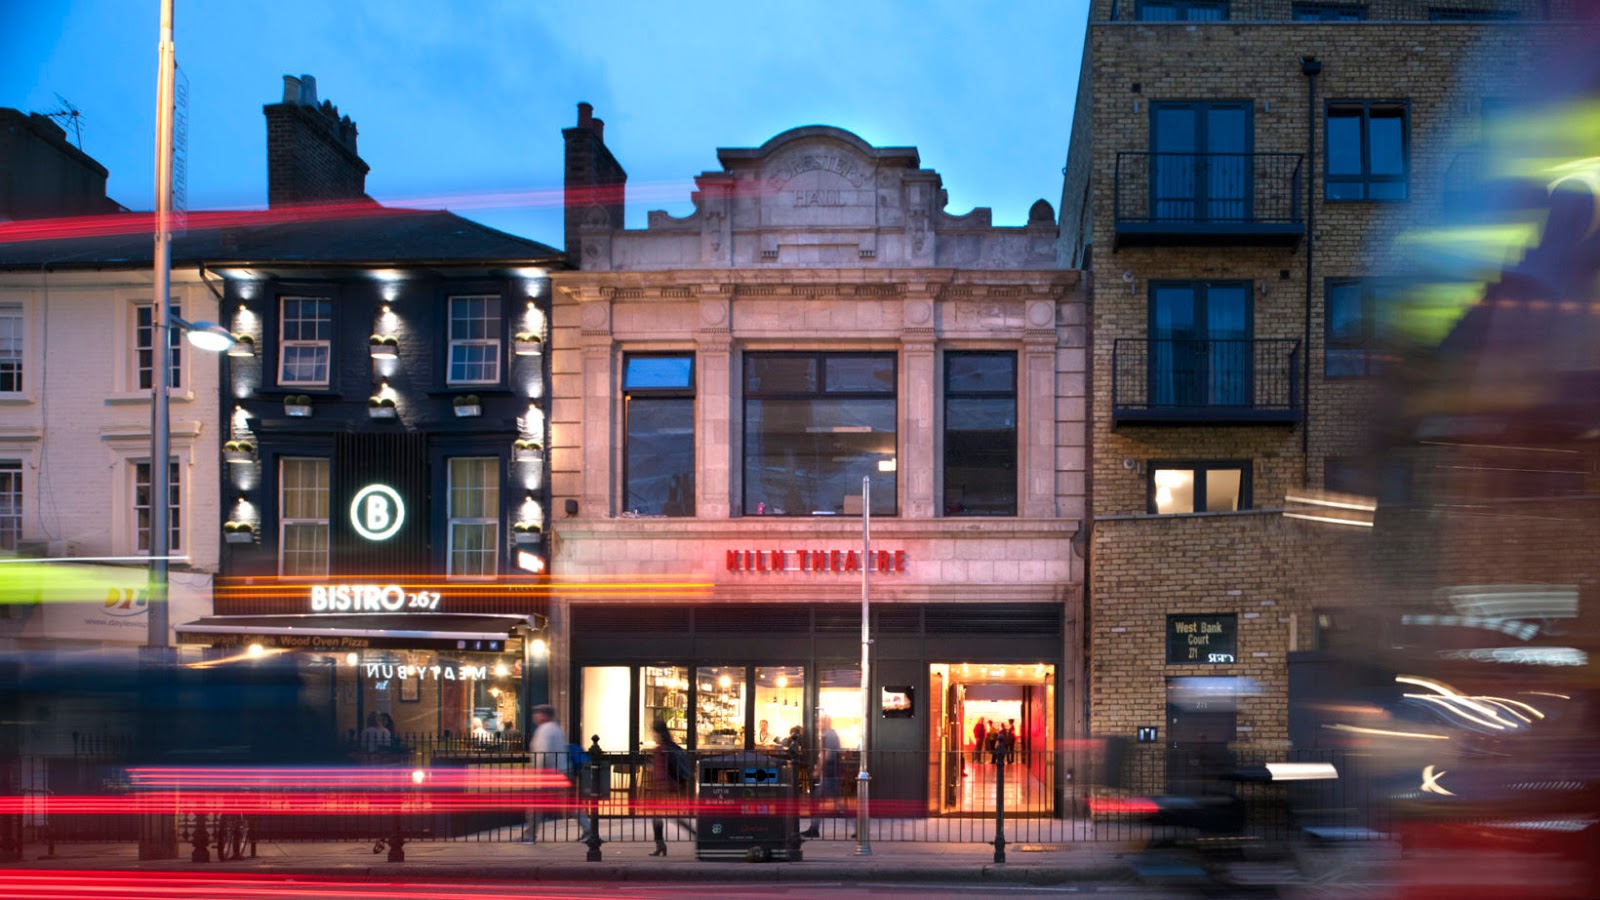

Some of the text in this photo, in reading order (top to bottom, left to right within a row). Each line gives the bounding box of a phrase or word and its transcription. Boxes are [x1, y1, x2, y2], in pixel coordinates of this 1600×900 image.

[766, 154, 864, 191] FORESTERS
[793, 189, 847, 208] HALL
[367, 494, 390, 531] B
[726, 549, 906, 571] KILN THEARE
[310, 584, 442, 611] BISTRO 267
[1175, 622, 1222, 633] West Bank
[280, 635, 310, 646] Wood
[312, 636, 339, 646] Oven
[341, 636, 370, 648] Pizza
[1188, 634, 1209, 645] Court
[1188, 647, 1198, 659] 271
